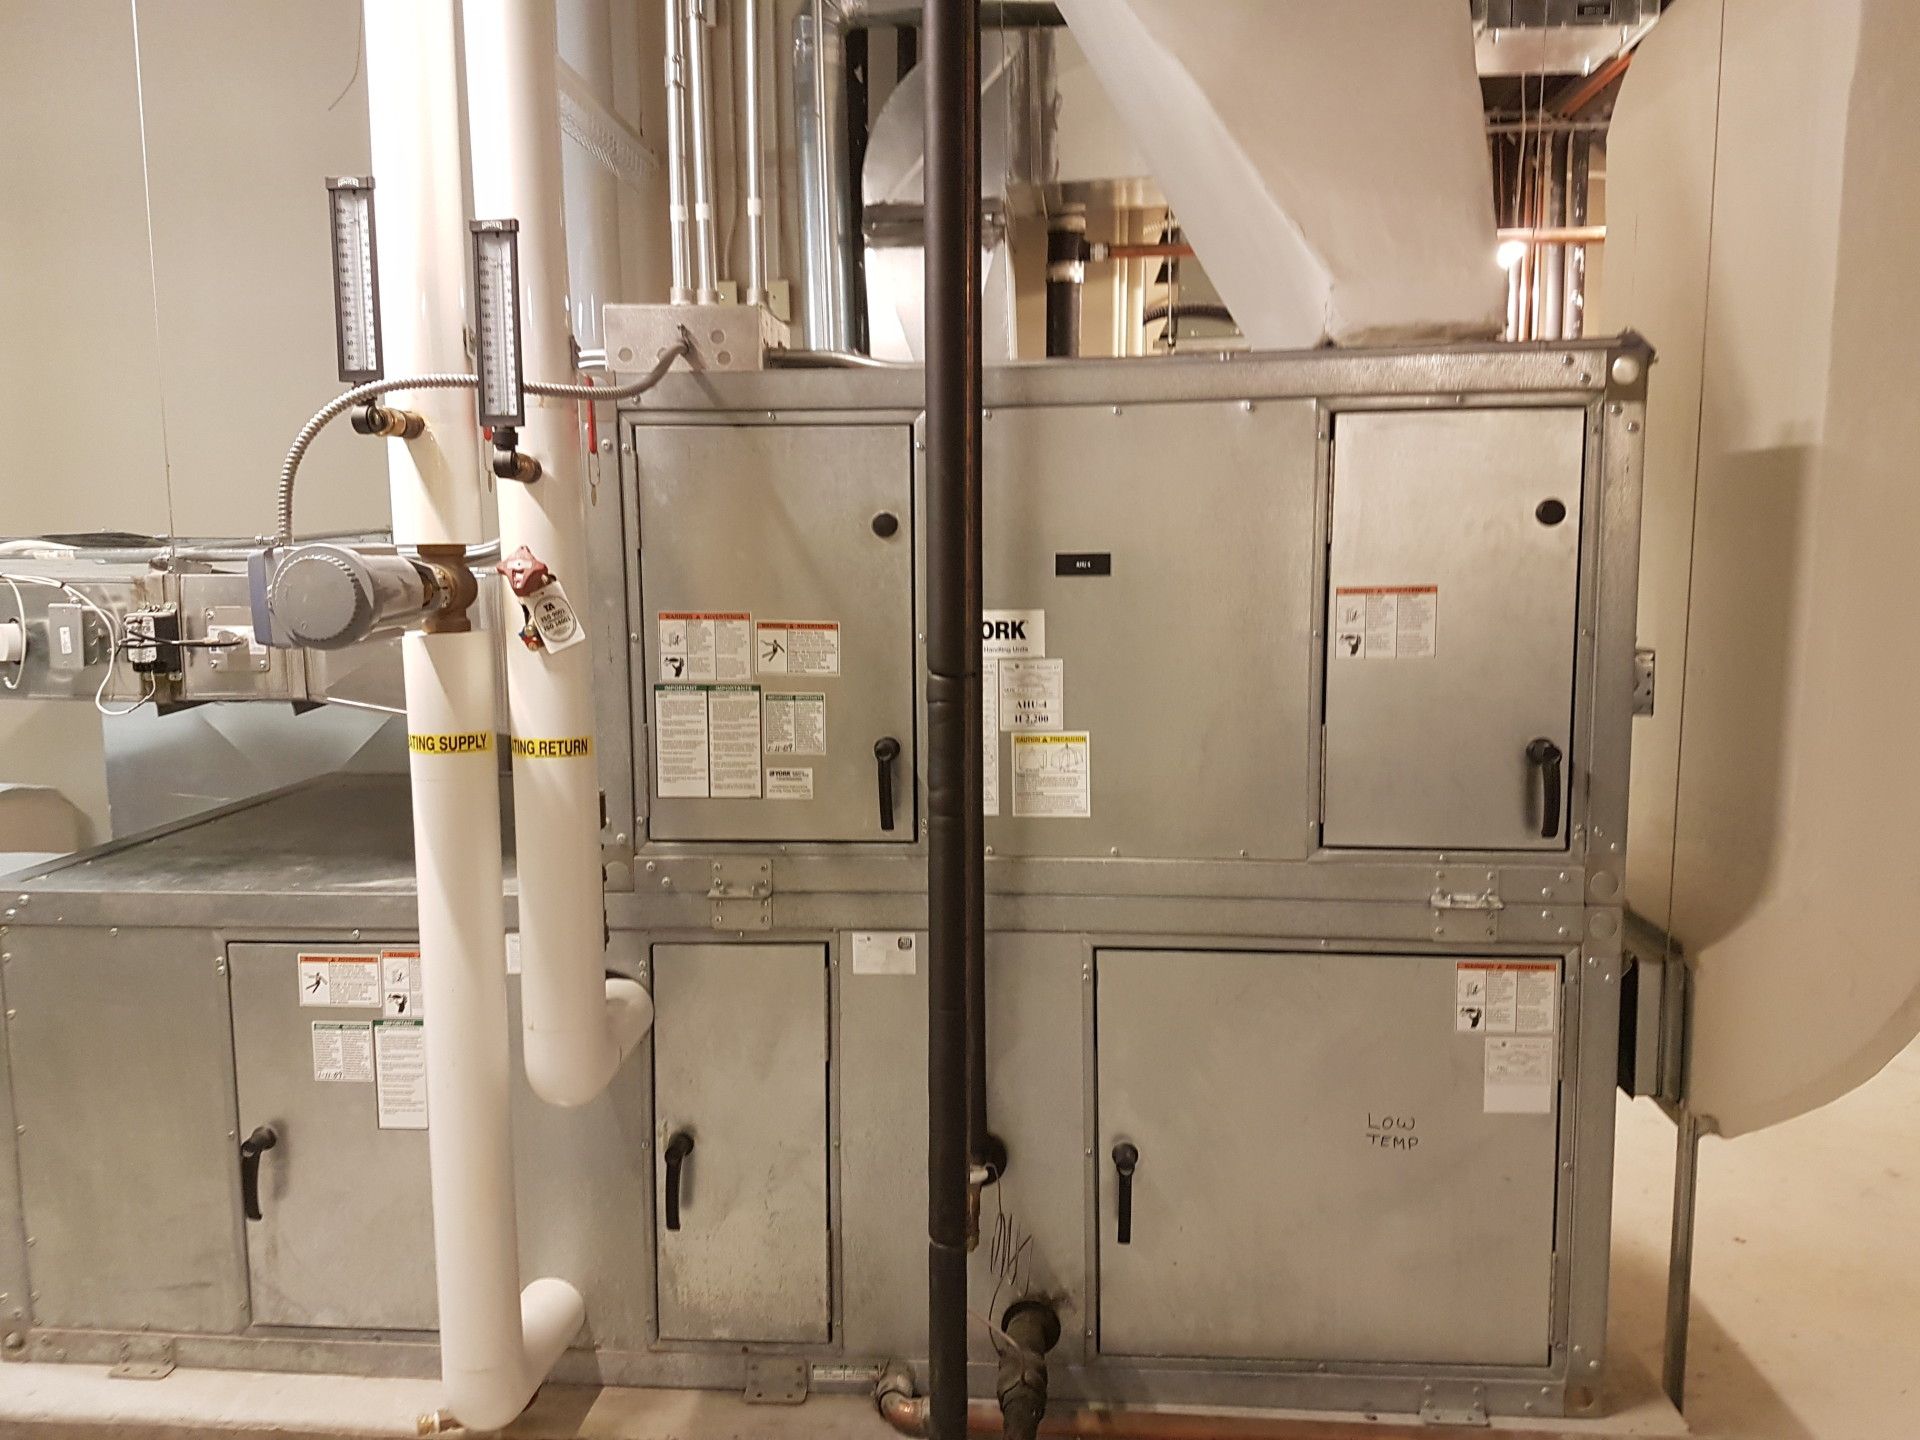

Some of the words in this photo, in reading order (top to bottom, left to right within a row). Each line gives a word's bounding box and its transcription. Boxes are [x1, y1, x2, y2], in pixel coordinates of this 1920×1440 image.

[439, 733, 487, 751] SUPPLY
[511, 739, 535, 755] TING
[539, 738, 588, 756] RETURN
[1368, 1112, 1416, 1131] LOW
[1365, 1133, 1419, 1150] TEMP
